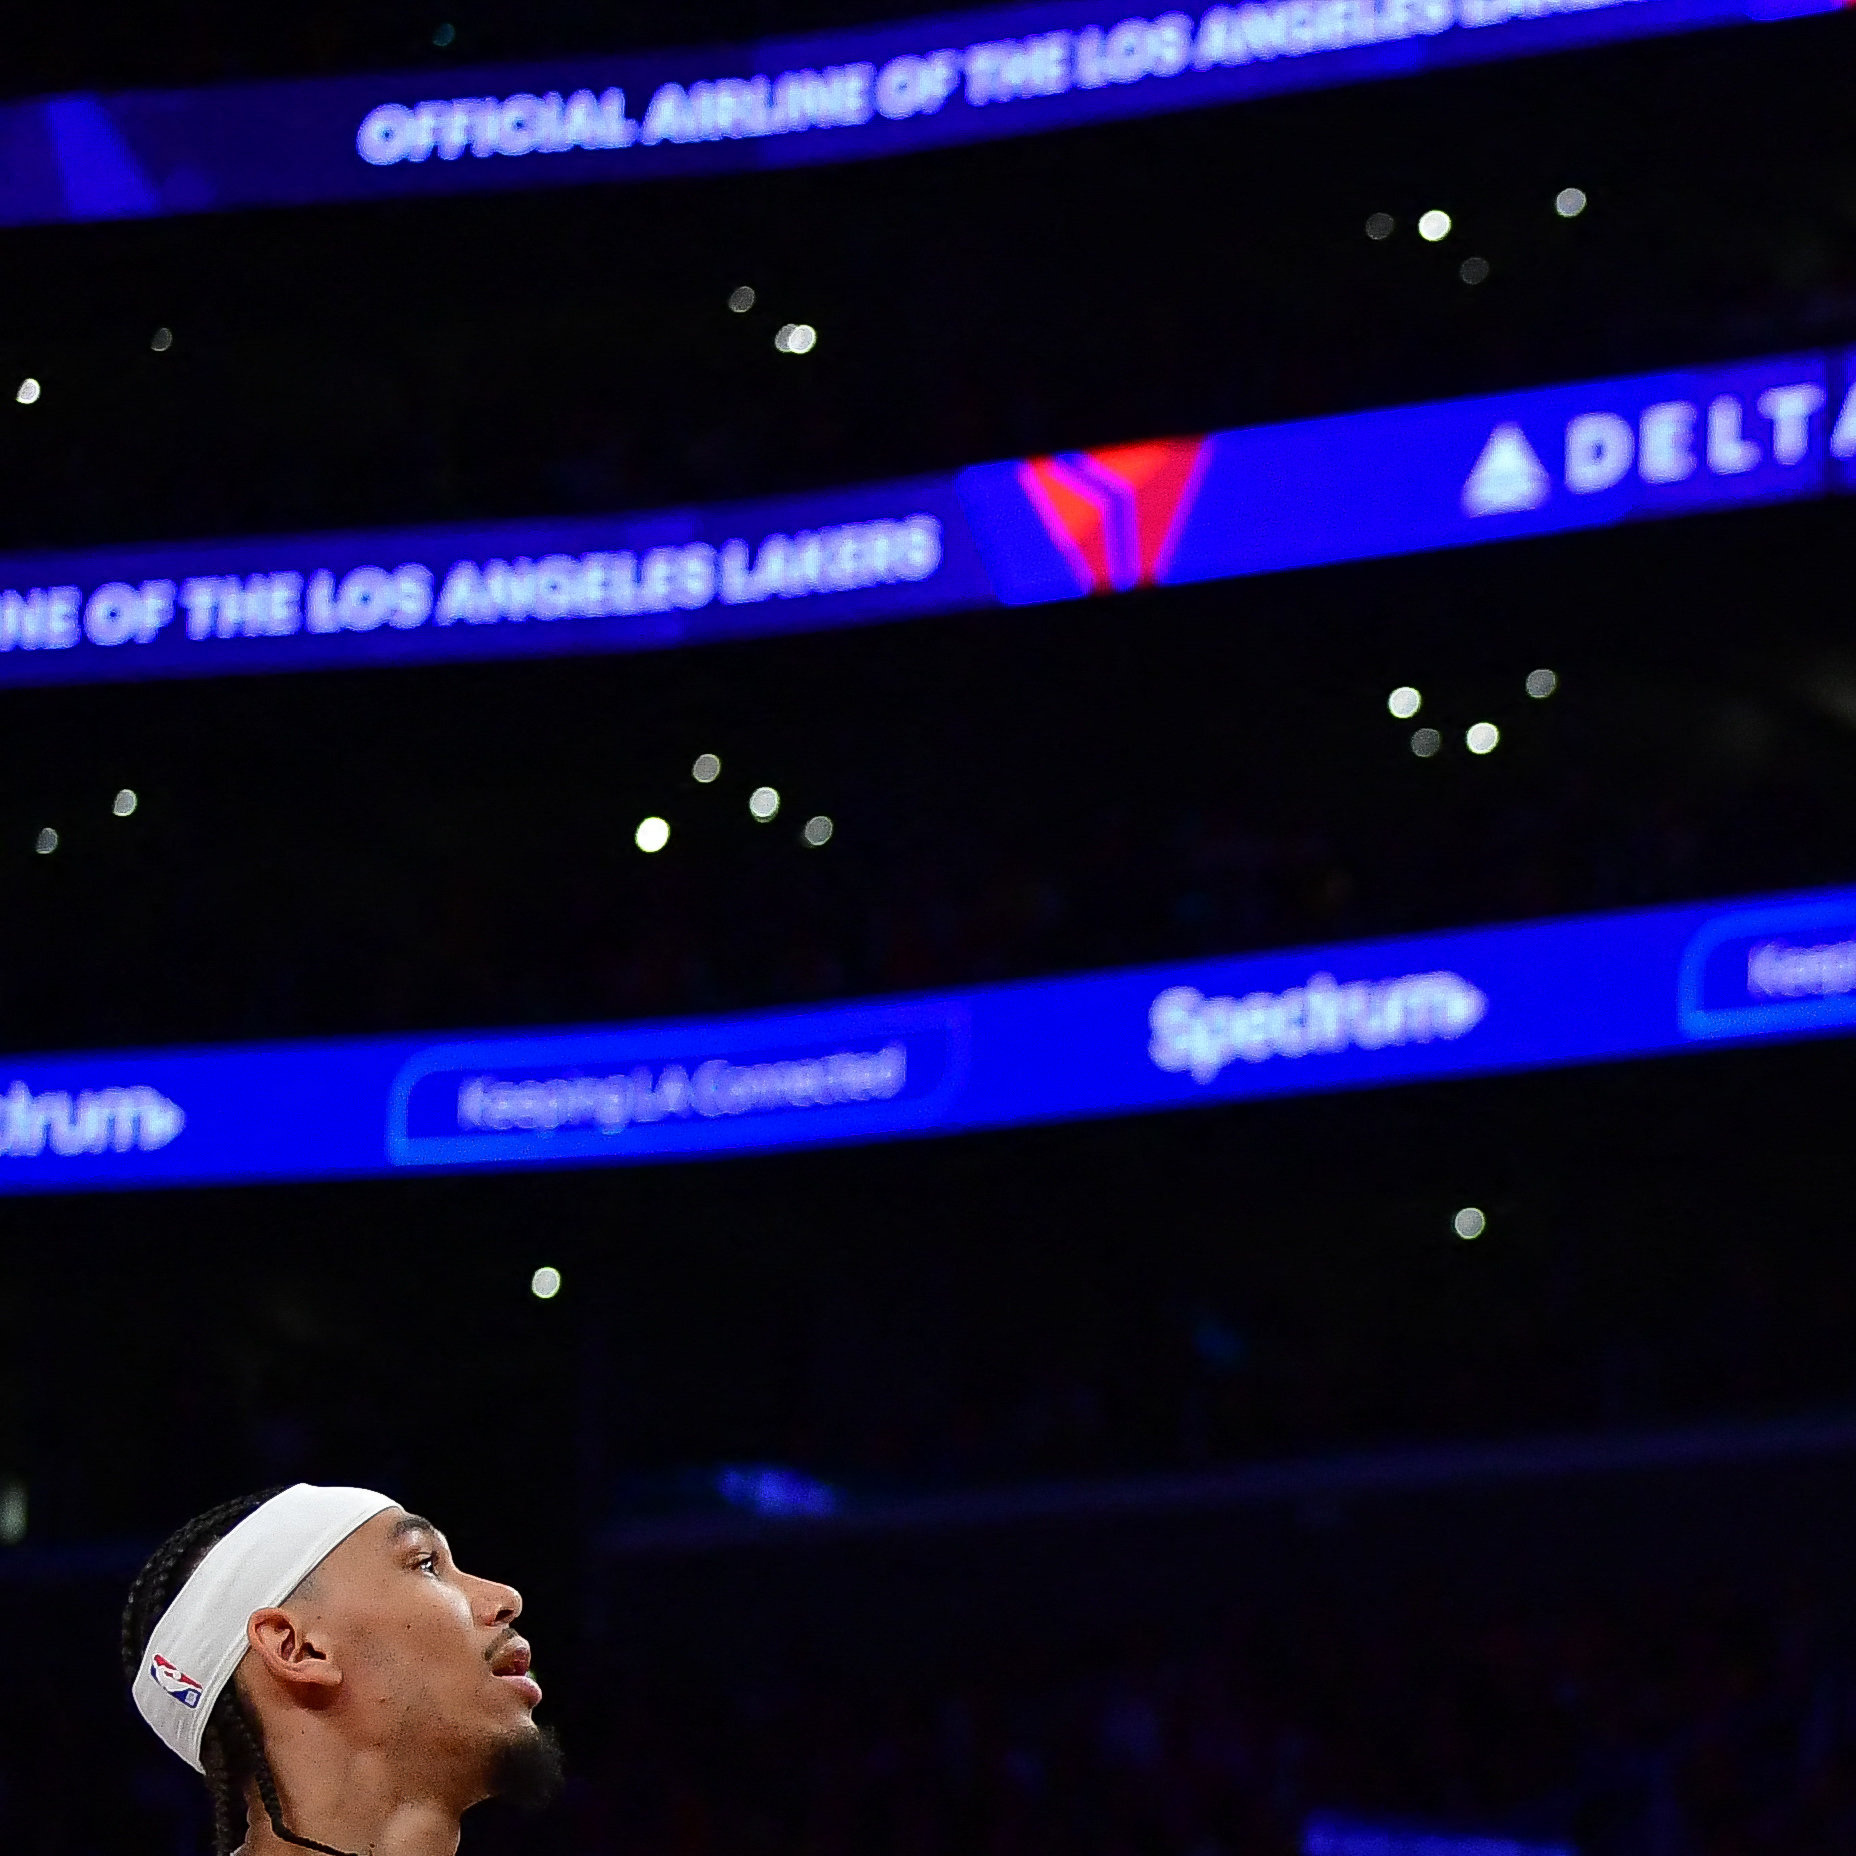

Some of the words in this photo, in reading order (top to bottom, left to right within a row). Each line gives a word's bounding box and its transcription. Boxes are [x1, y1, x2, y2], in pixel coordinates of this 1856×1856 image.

[357, 87, 639, 166] OFFICIAL
[641, 62, 875, 146] AIRLINE
[876, 48, 962, 120] OF
[963, 30, 1072, 106] THE
[1073, 11, 1193, 91] LOS
[84, 580, 175, 645] OF
[182, 570, 304, 640] THE
[307, 563, 434, 633] LOS
[435, 541, 716, 627] ANGELES
[717, 513, 942, 605] LAKERS
[1149, 971, 1474, 1085] Spectrum
